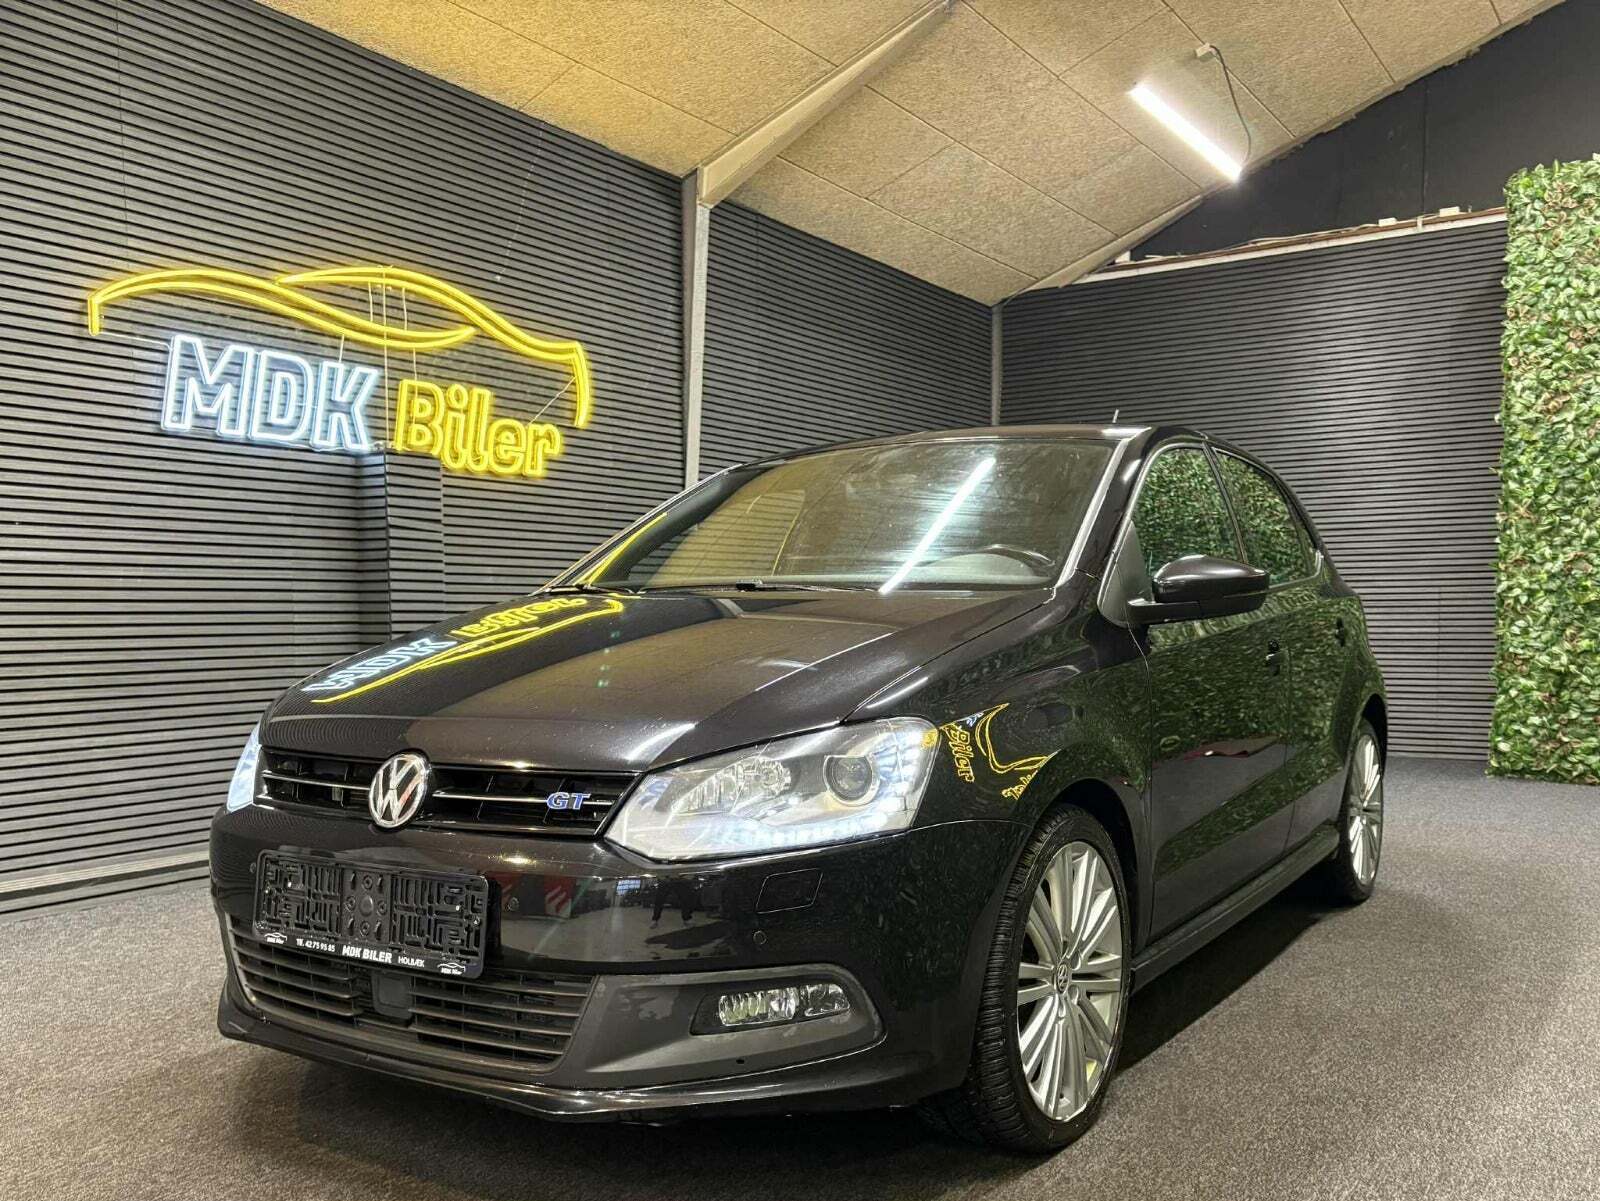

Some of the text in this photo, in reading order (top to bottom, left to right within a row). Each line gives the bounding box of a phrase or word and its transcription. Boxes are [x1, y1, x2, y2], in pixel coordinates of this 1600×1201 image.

[160, 334, 562, 477] MDK Biler
[546, 791, 591, 811] GT
[342, 944, 362, 958] MDK
[362, 948, 392, 964] BILER
